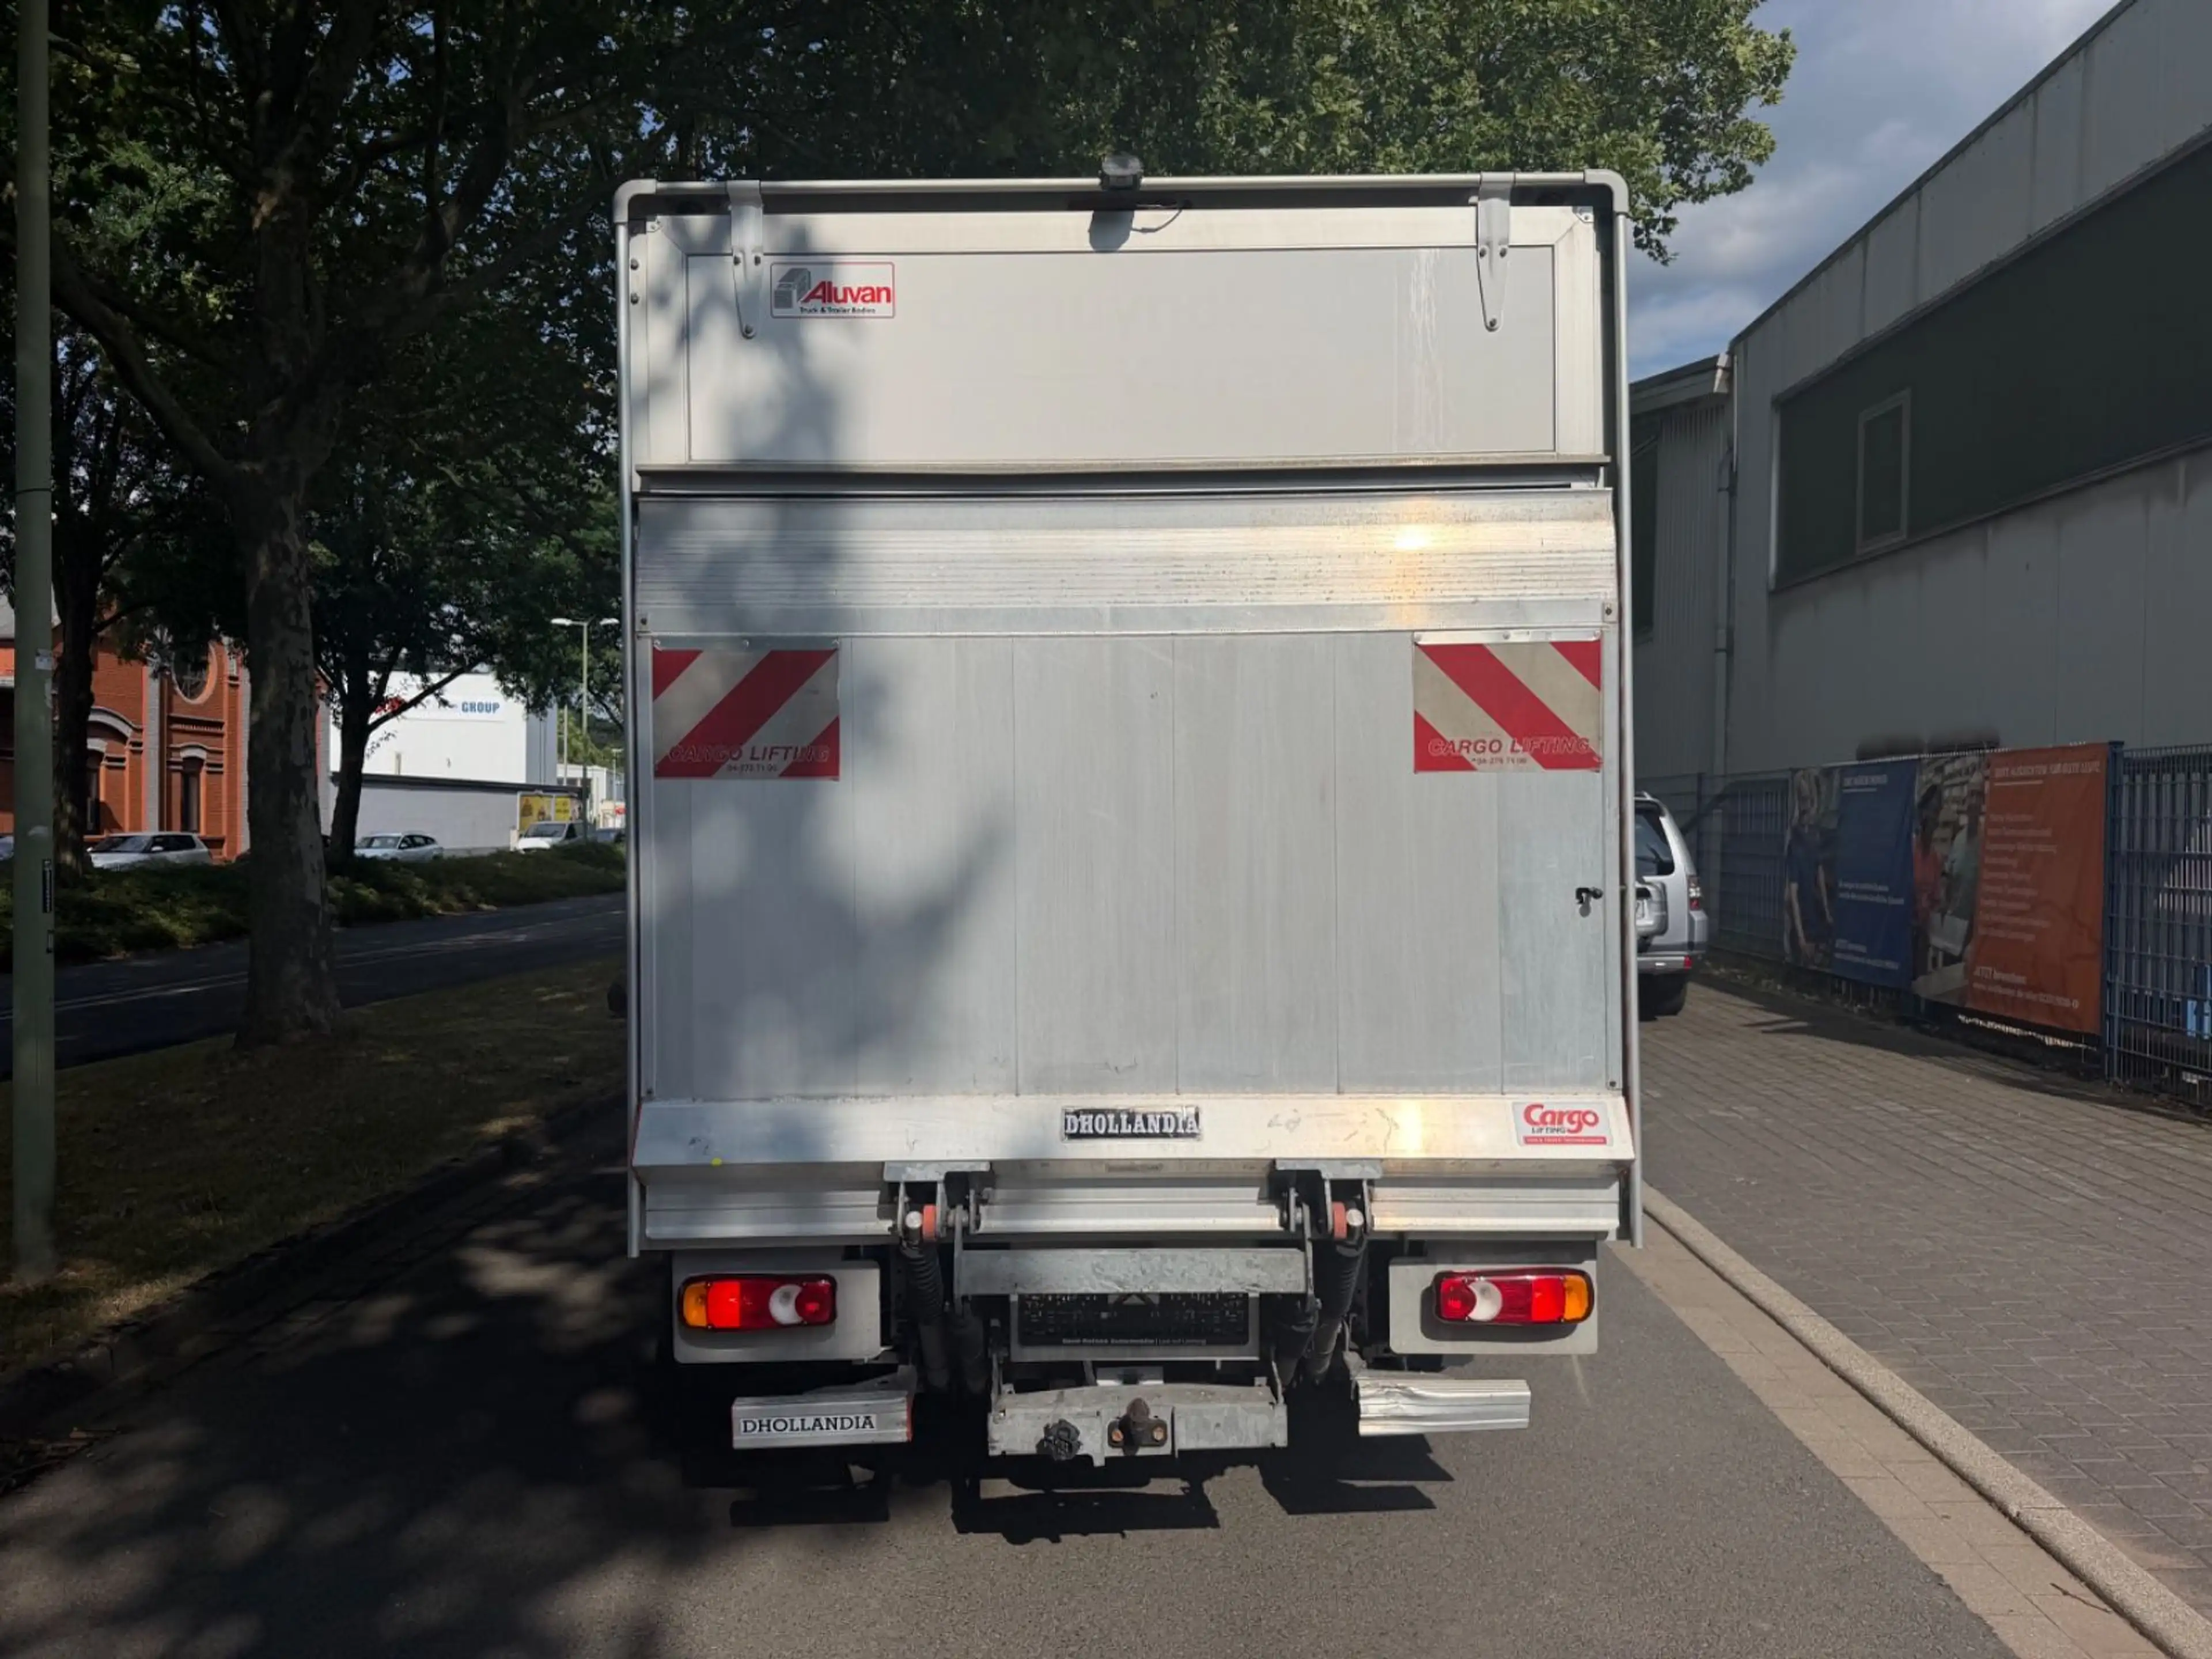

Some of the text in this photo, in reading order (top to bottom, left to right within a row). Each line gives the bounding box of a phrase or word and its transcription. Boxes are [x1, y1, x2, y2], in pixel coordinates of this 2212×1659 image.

[801, 281, 891, 303] Aluvan
[461, 702, 500, 714] GROUP
[669, 745, 830, 762] CARGO LIFTING
[1428, 737, 1590, 756] CARGO LIFTING
[1066, 1113, 1199, 1134] DHOLLANDIA
[1524, 1104, 1599, 1134] Cargo
[742, 1415, 874, 1433] DHOLLANDIA
